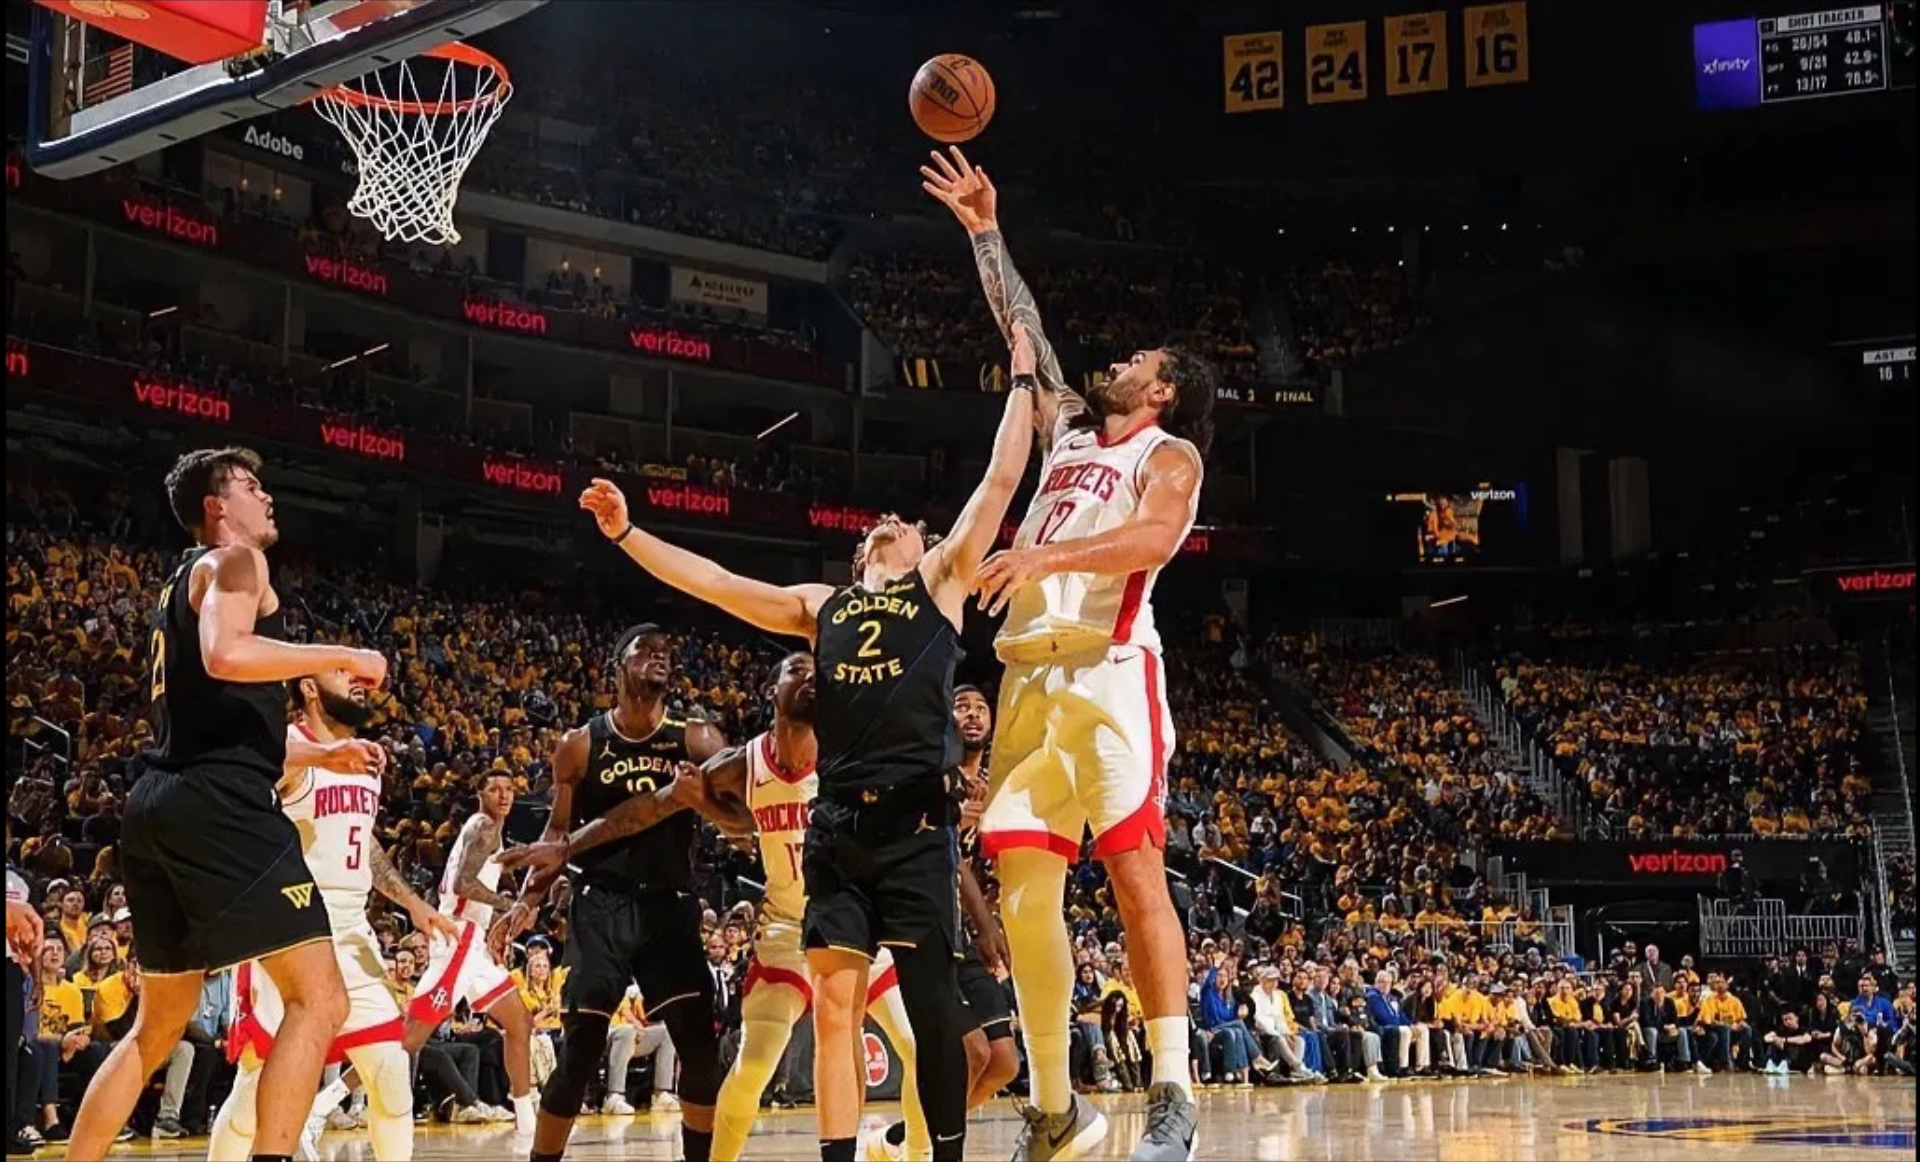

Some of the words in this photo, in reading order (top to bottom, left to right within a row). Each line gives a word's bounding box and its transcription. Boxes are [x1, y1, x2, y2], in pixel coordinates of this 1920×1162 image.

[1819, 9, 1864, 23] TRACKER
[1311, 50, 1362, 93] 24
[1397, 42, 1435, 84] 17
[1476, 33, 1517, 76] 16
[1702, 57, 1751, 75] xfinity
[1229, 61, 1279, 102] 42
[1796, 74, 1828, 92] 13/17
[244, 125, 304, 160] Adobe
[124, 200, 217, 245] verizon
[306, 253, 388, 293] verizon
[463, 300, 547, 333] verizon
[630, 329, 711, 359] verizon
[134, 378, 231, 422] verizon
[1275, 390, 1315, 402] FINAL
[321, 422, 404, 461] verizon
[482, 459, 562, 493] verizon
[648, 486, 730, 516] verizon
[1470, 489, 1517, 501] verizon
[831, 595, 920, 625] GOLDEN
[857, 620, 883, 658] 2
[833, 658, 904, 684] STATE
[347, 826, 361, 870] 5
[1629, 849, 1727, 873] verizon
